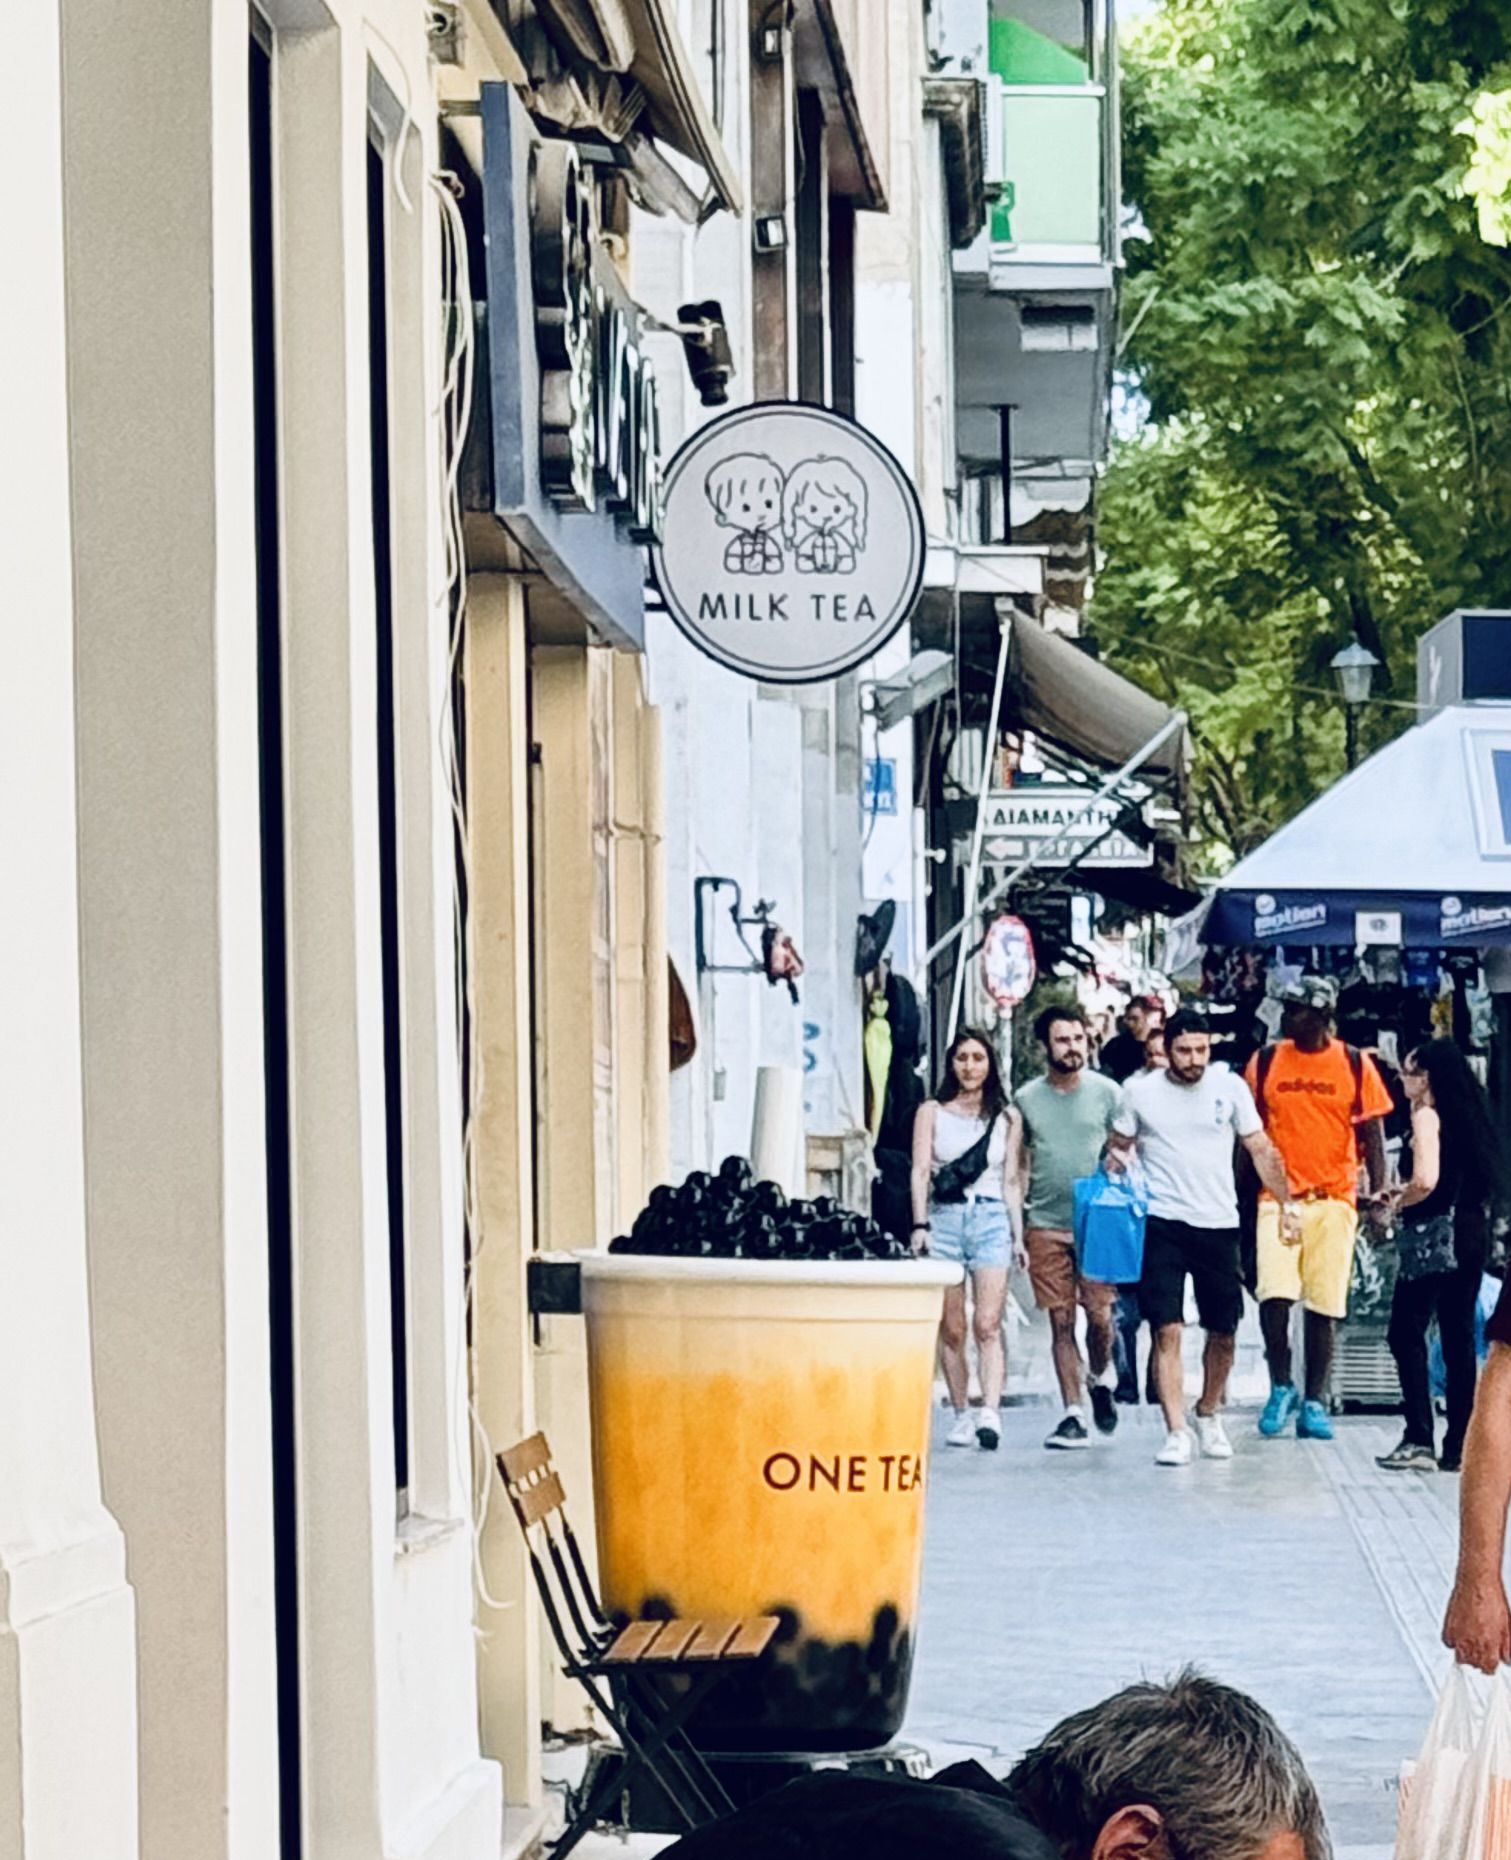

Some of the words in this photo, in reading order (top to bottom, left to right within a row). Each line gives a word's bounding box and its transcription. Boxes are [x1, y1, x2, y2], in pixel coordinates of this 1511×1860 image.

[699, 592, 789, 621] MILK
[810, 593, 876, 622] TEA
[1255, 905, 1326, 930] motion
[763, 1452, 867, 1493] ONE
[879, 1453, 922, 1493] TEA
